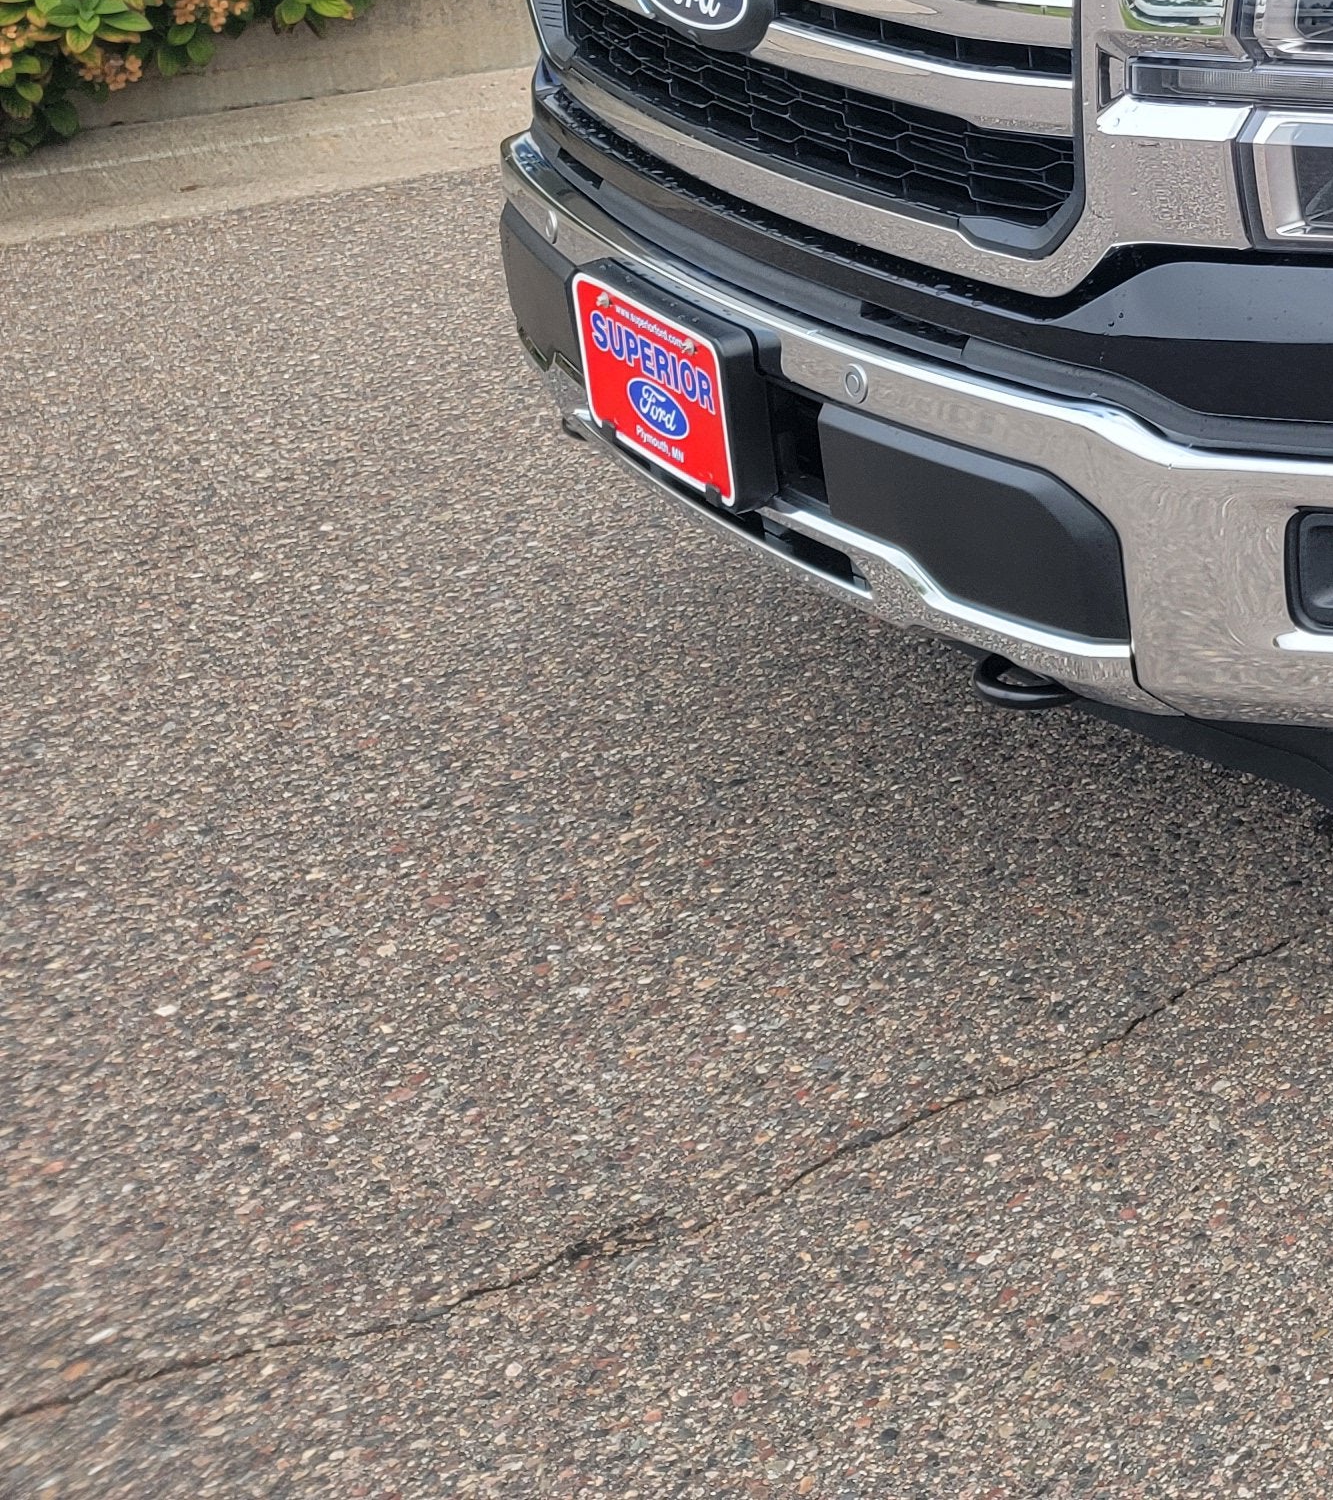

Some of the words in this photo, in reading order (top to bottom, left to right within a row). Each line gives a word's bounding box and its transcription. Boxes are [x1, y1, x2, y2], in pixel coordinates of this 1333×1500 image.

[590, 311, 716, 414] SUPERIOR
[639, 384, 677, 432] Ford
[635, 425, 671, 457] Plymouth,
[671, 446, 685, 463] MN
